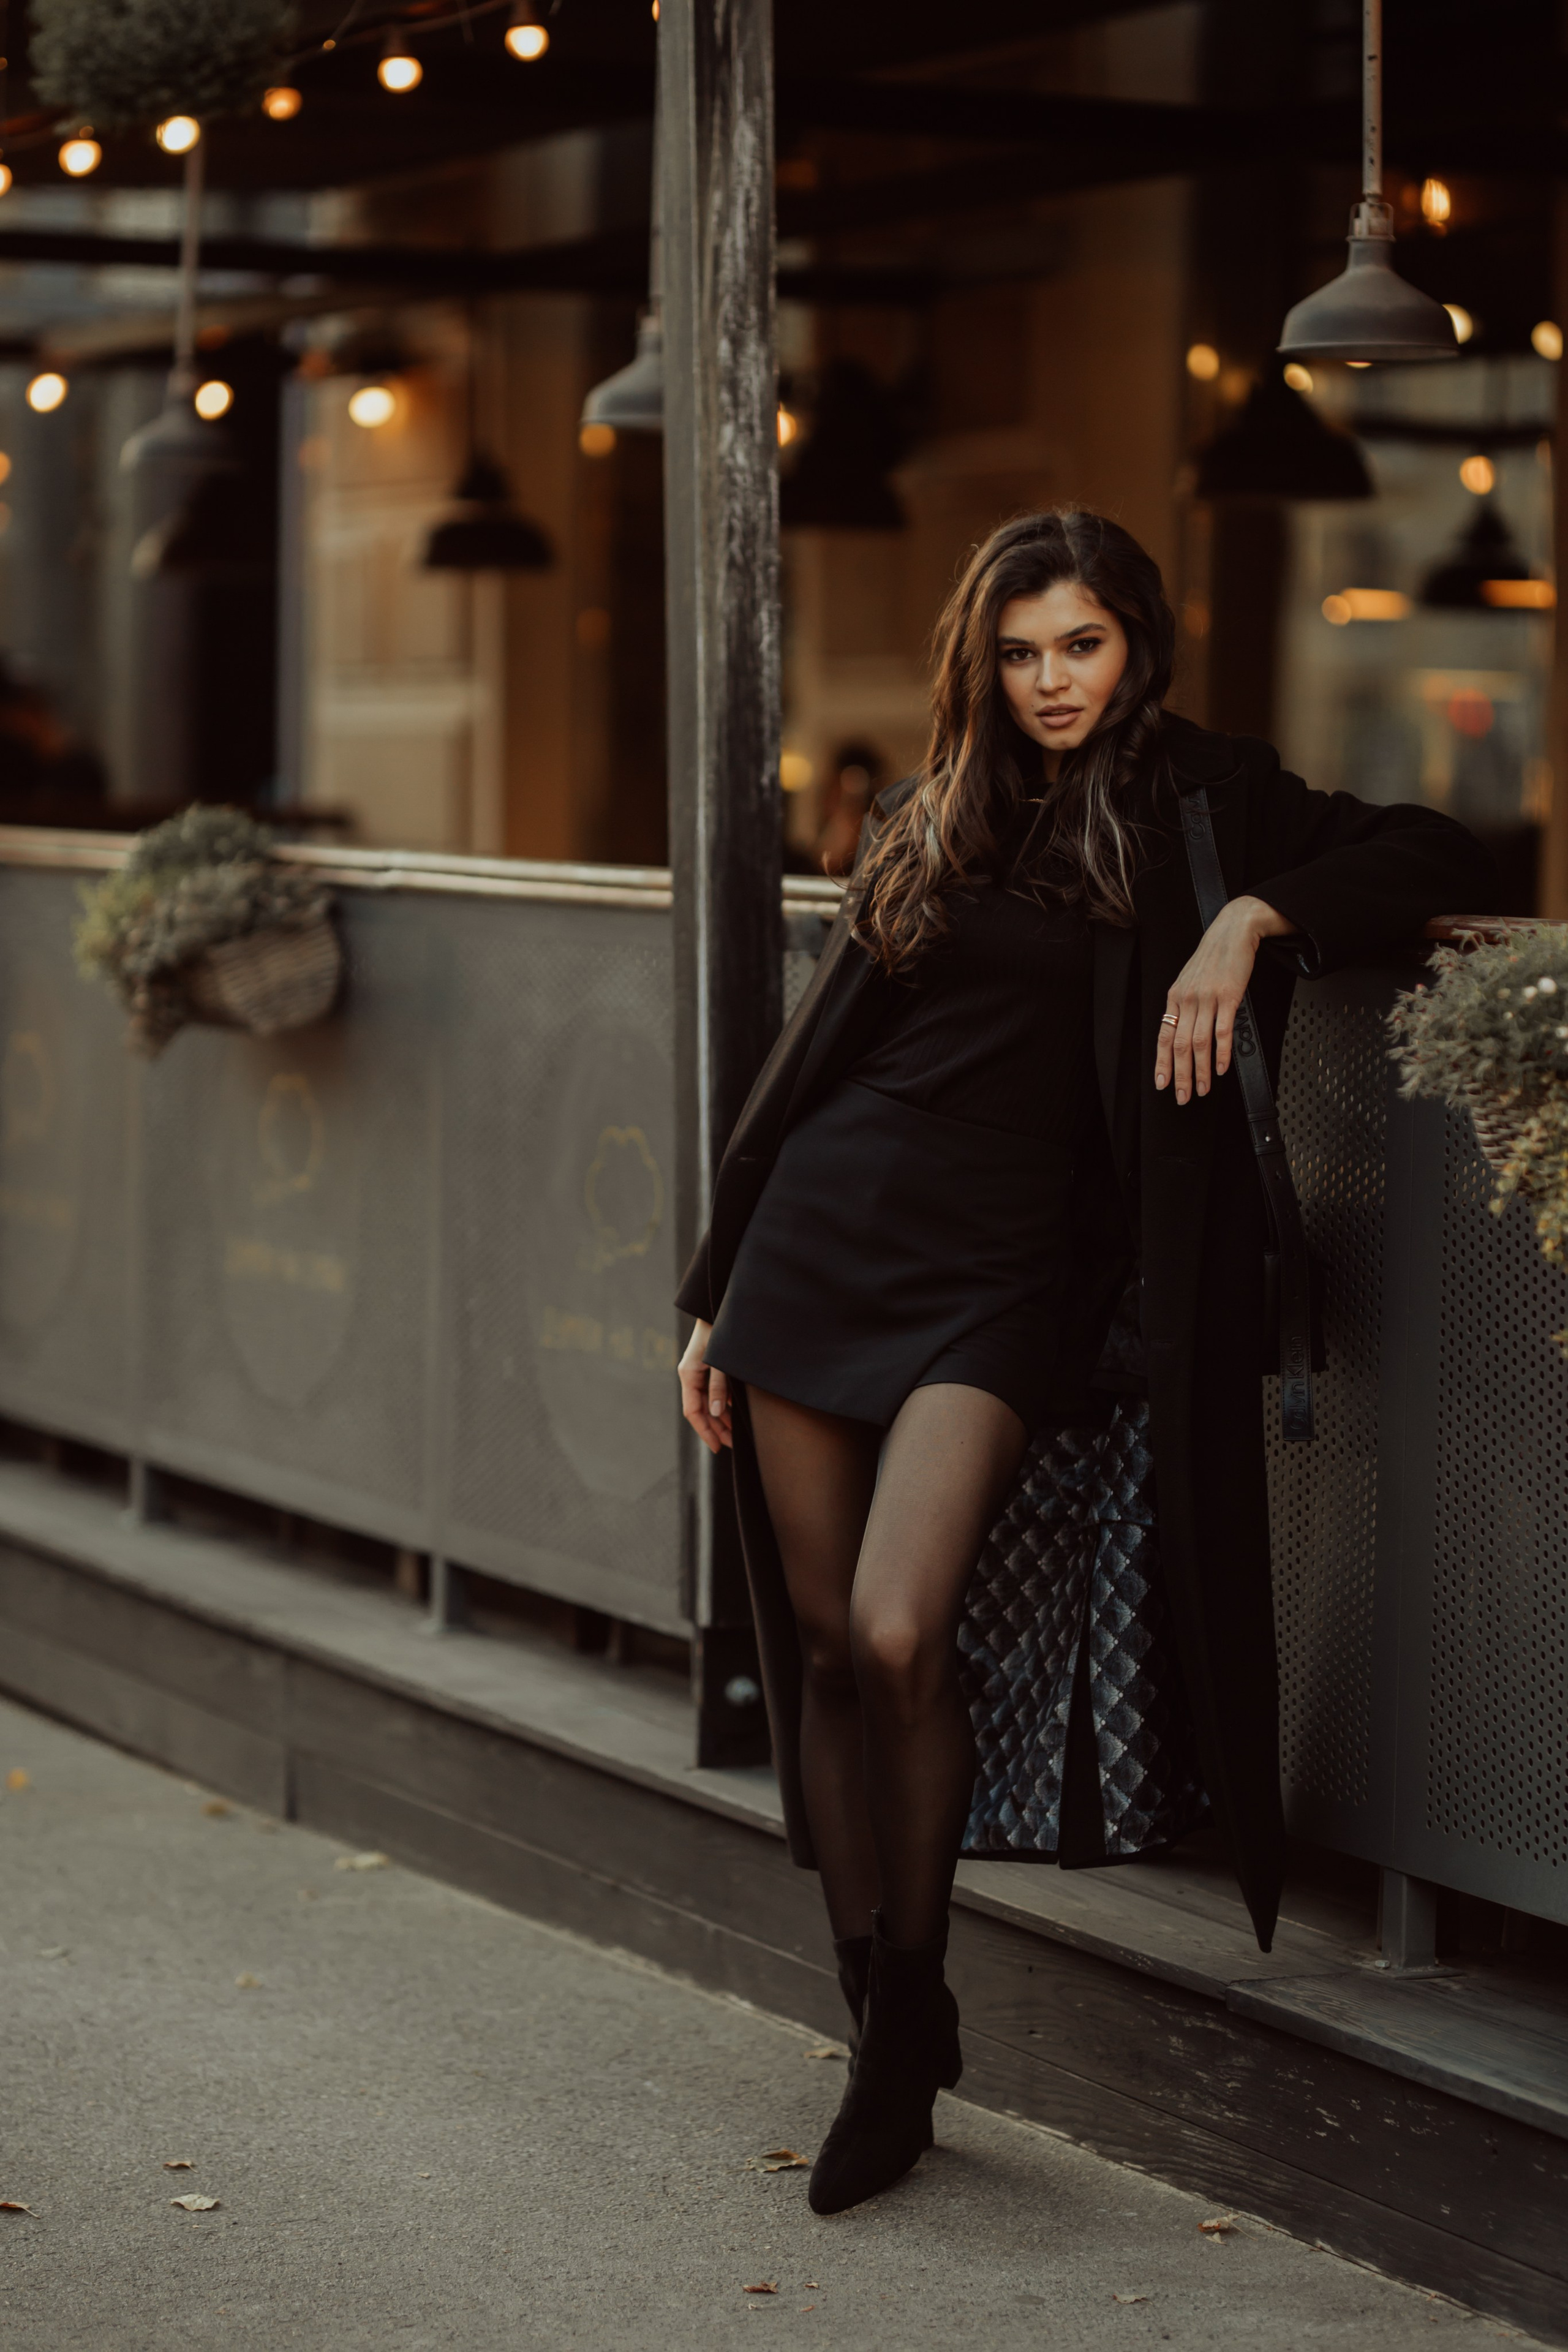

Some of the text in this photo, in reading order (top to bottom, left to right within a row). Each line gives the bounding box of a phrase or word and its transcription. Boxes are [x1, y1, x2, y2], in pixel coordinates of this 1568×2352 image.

[1235, 1004, 1256, 1057] Calvi
[1287, 1336, 1307, 1430] Calvin Klein
